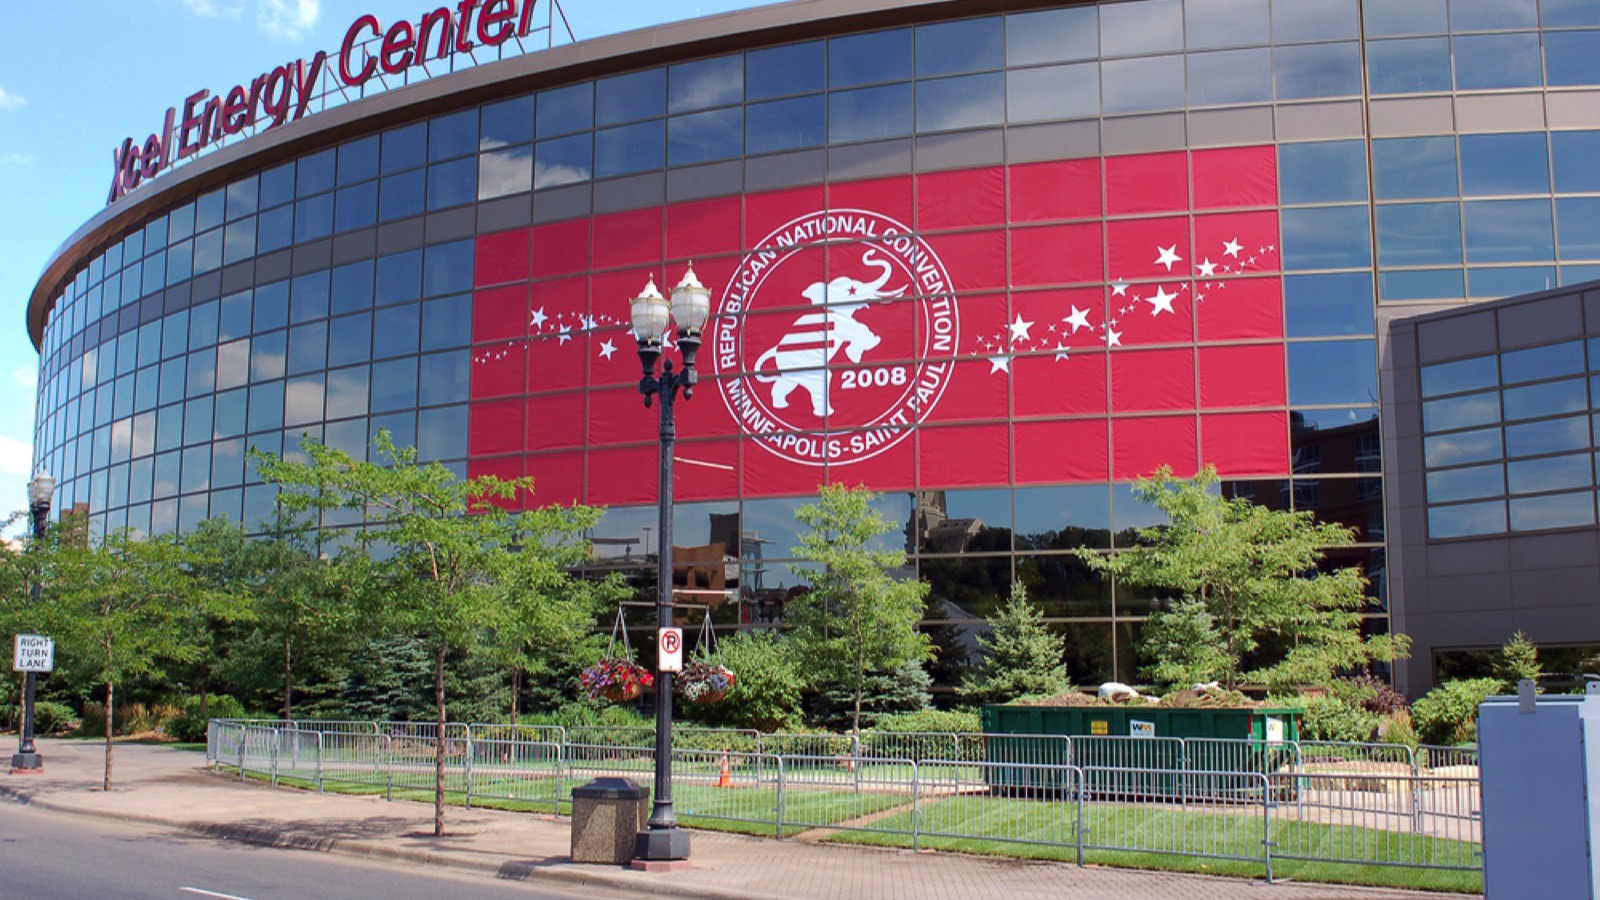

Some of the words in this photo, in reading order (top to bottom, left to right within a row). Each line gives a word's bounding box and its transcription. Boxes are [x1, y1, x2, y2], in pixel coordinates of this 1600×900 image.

[106, 107, 176, 206] Xcel
[177, 51, 327, 159] Energy
[339, 0, 538, 86] Center
[720, 244, 777, 369] REPUBLICAN
[776, 216, 878, 251] NATIONAL
[883, 227, 952, 351] CONVENTION
[841, 367, 907, 389] 2008
[907, 362, 947, 413] PAUL
[20, 638, 49, 647] RIGHT
[21, 648, 48, 657] TURN
[19, 659, 46, 668] LANE
